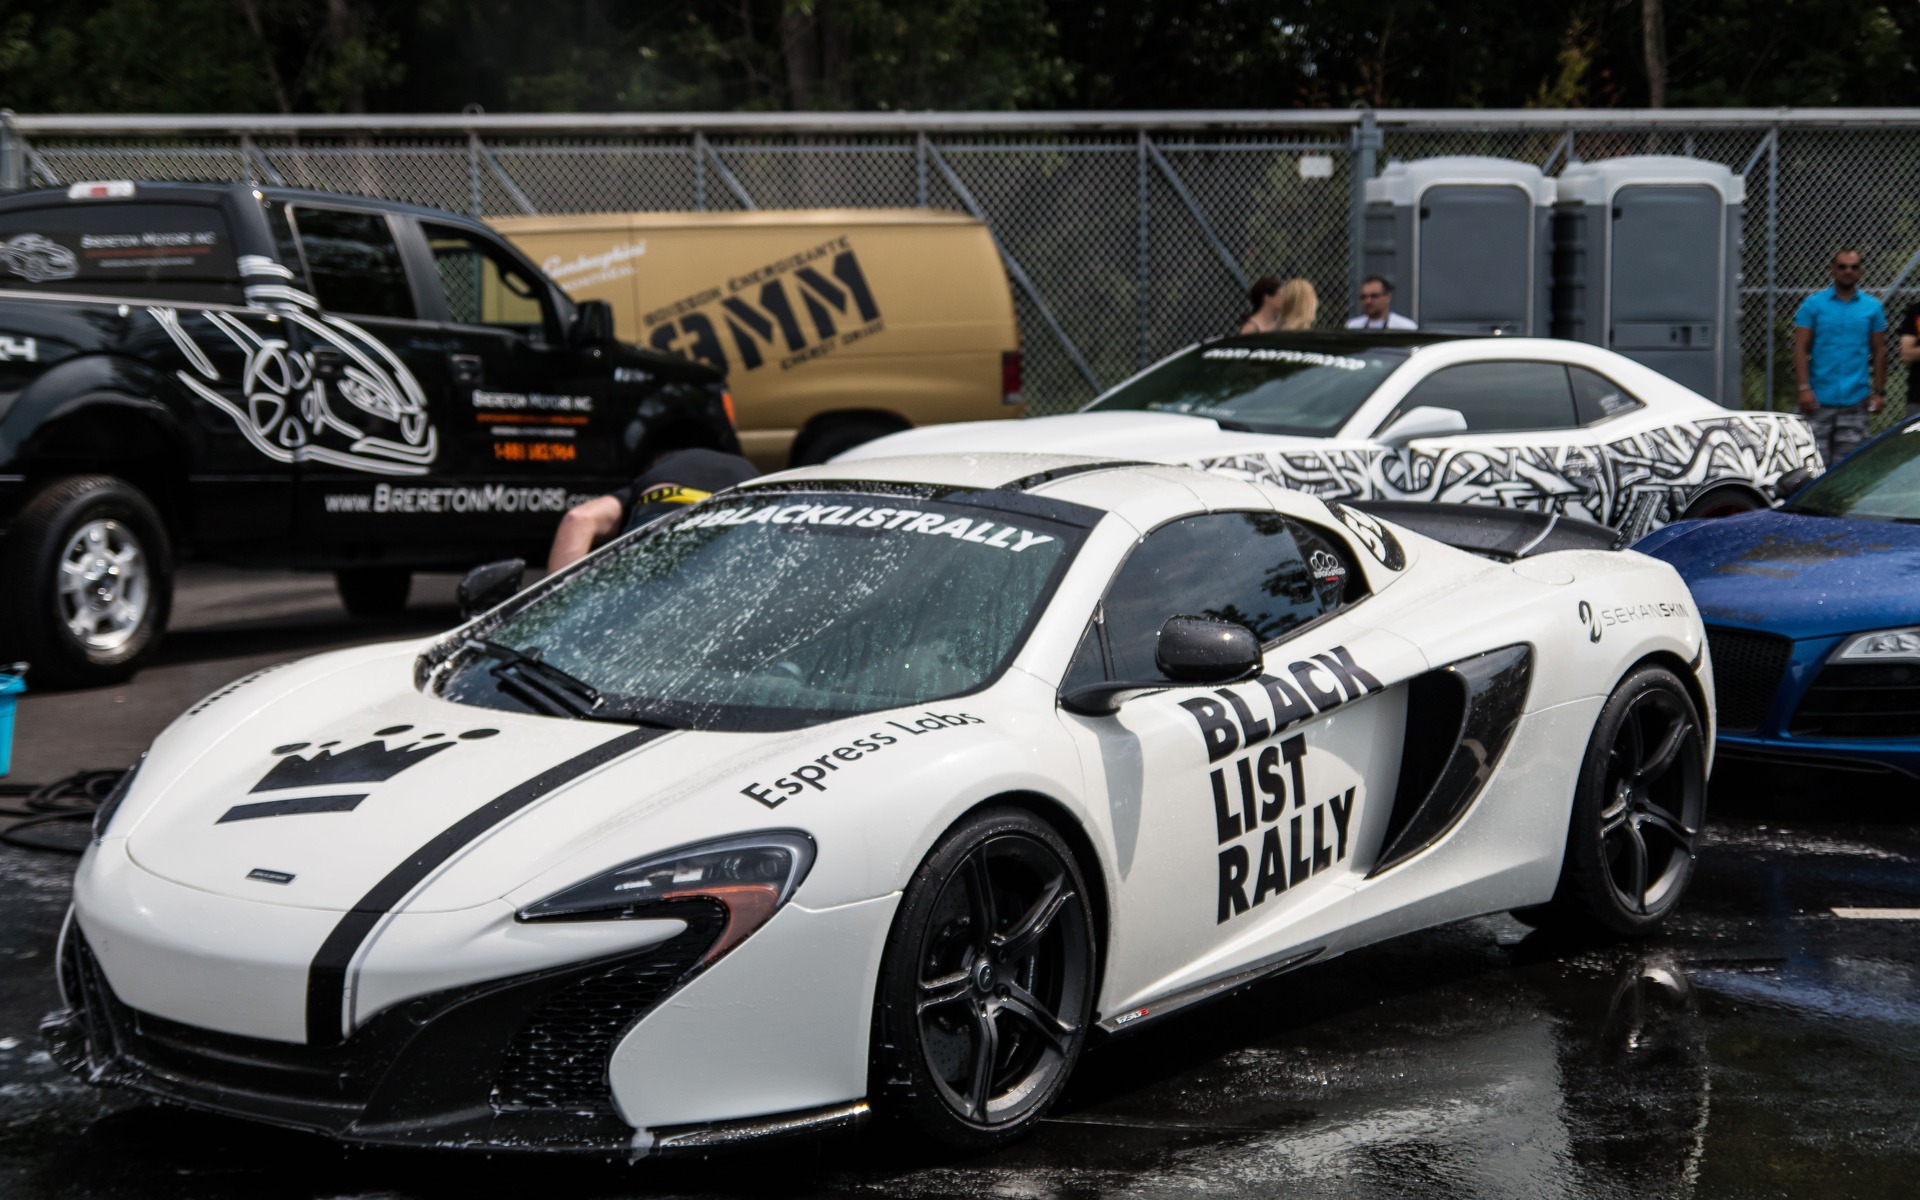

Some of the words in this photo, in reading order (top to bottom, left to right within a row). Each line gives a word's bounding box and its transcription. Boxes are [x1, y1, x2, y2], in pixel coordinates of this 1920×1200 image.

[740, 732, 898, 810] Espress
[886, 711, 985, 736] Labs
[1177, 645, 1385, 764] BLACK
[1210, 732, 1307, 846] LIST
[1217, 785, 1356, 926] RALLY
